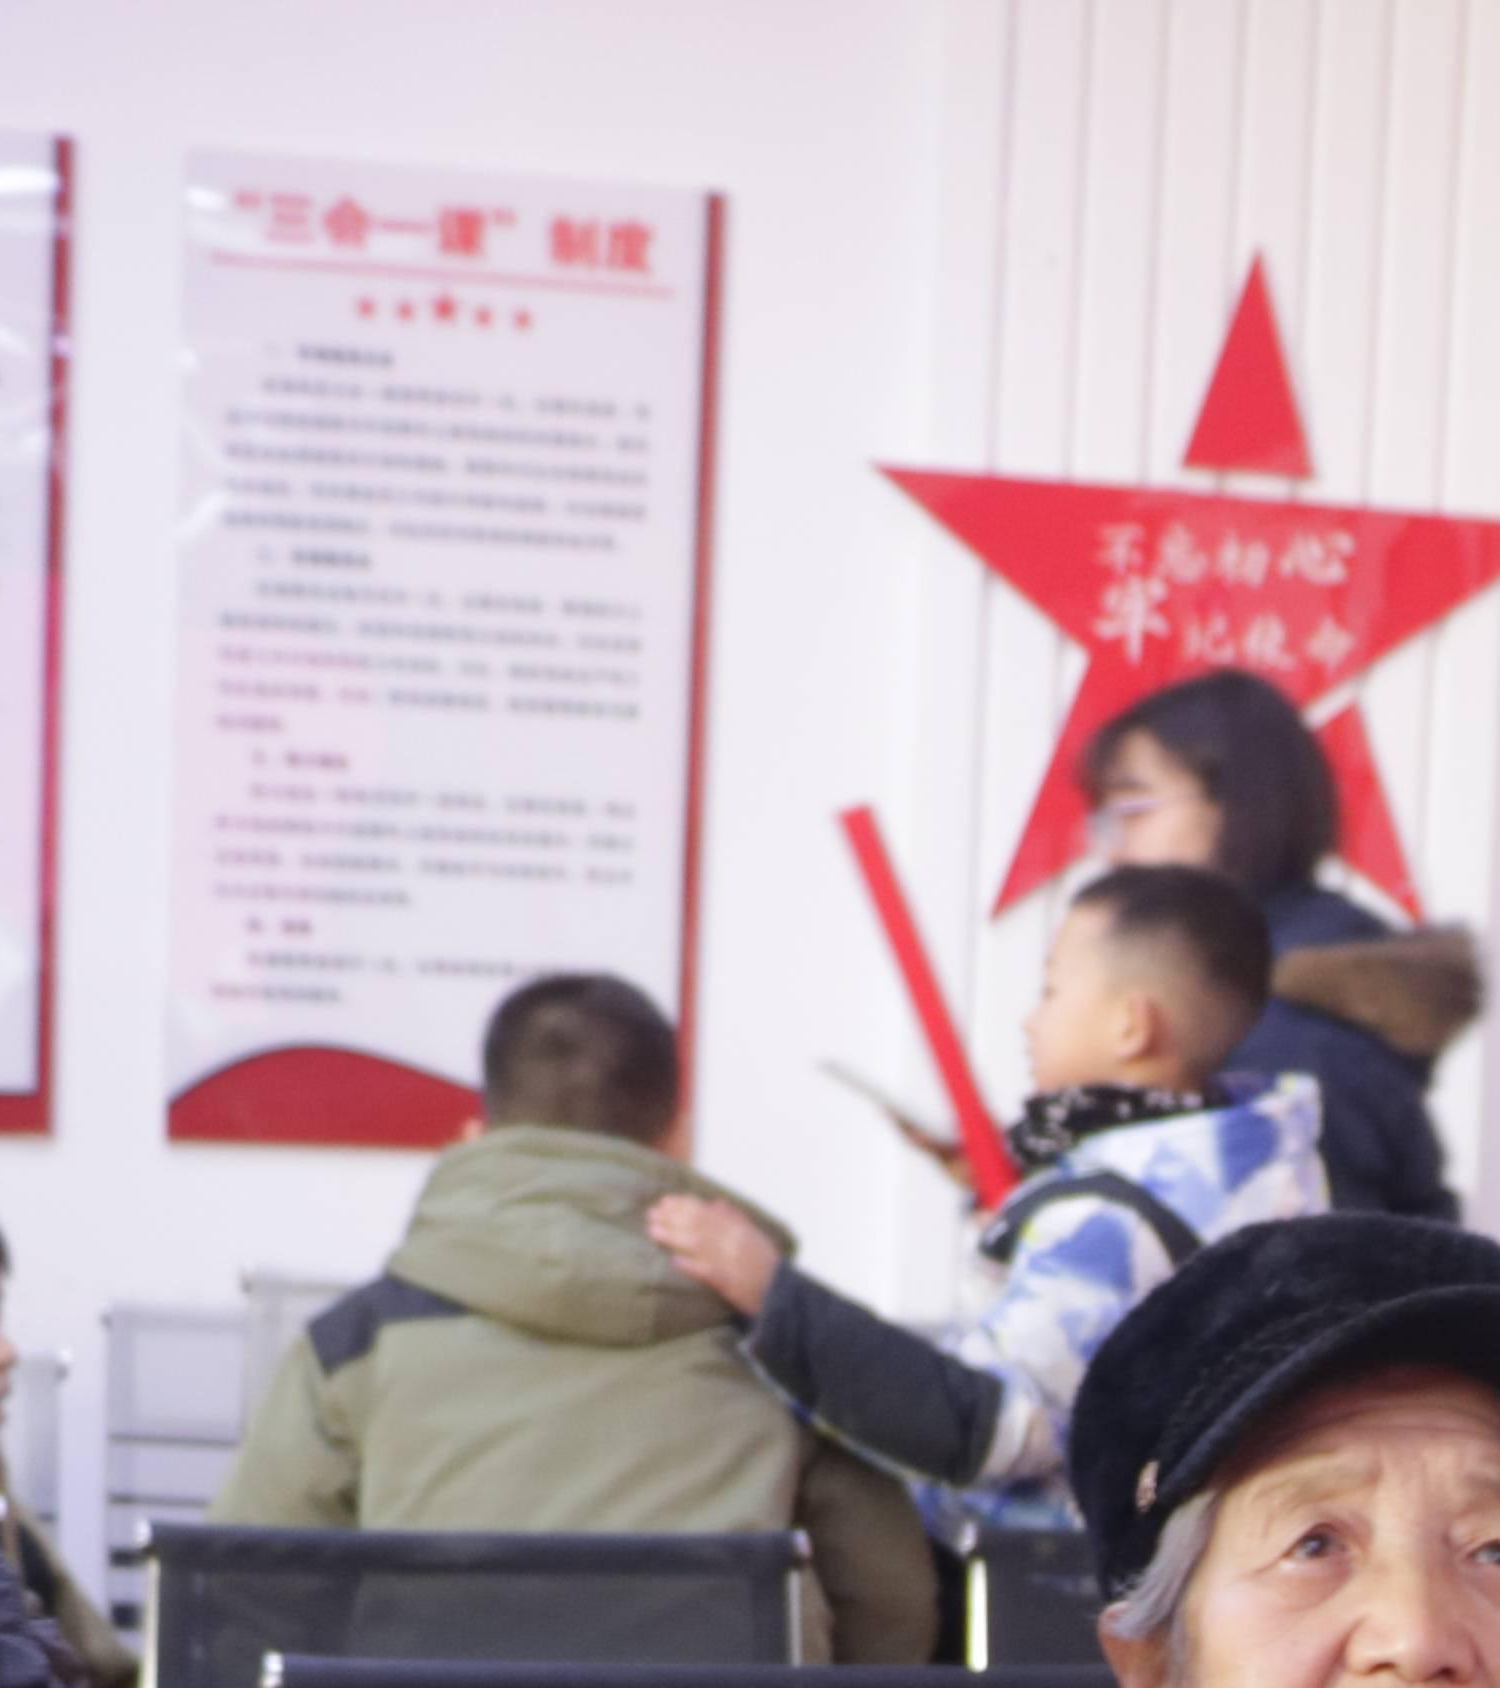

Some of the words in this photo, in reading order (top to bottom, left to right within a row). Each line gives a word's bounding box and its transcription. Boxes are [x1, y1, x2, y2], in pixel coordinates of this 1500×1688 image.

[1093, 522, 1357, 589] 不忘初心
[1089, 573, 1357, 673] 牢记使命
